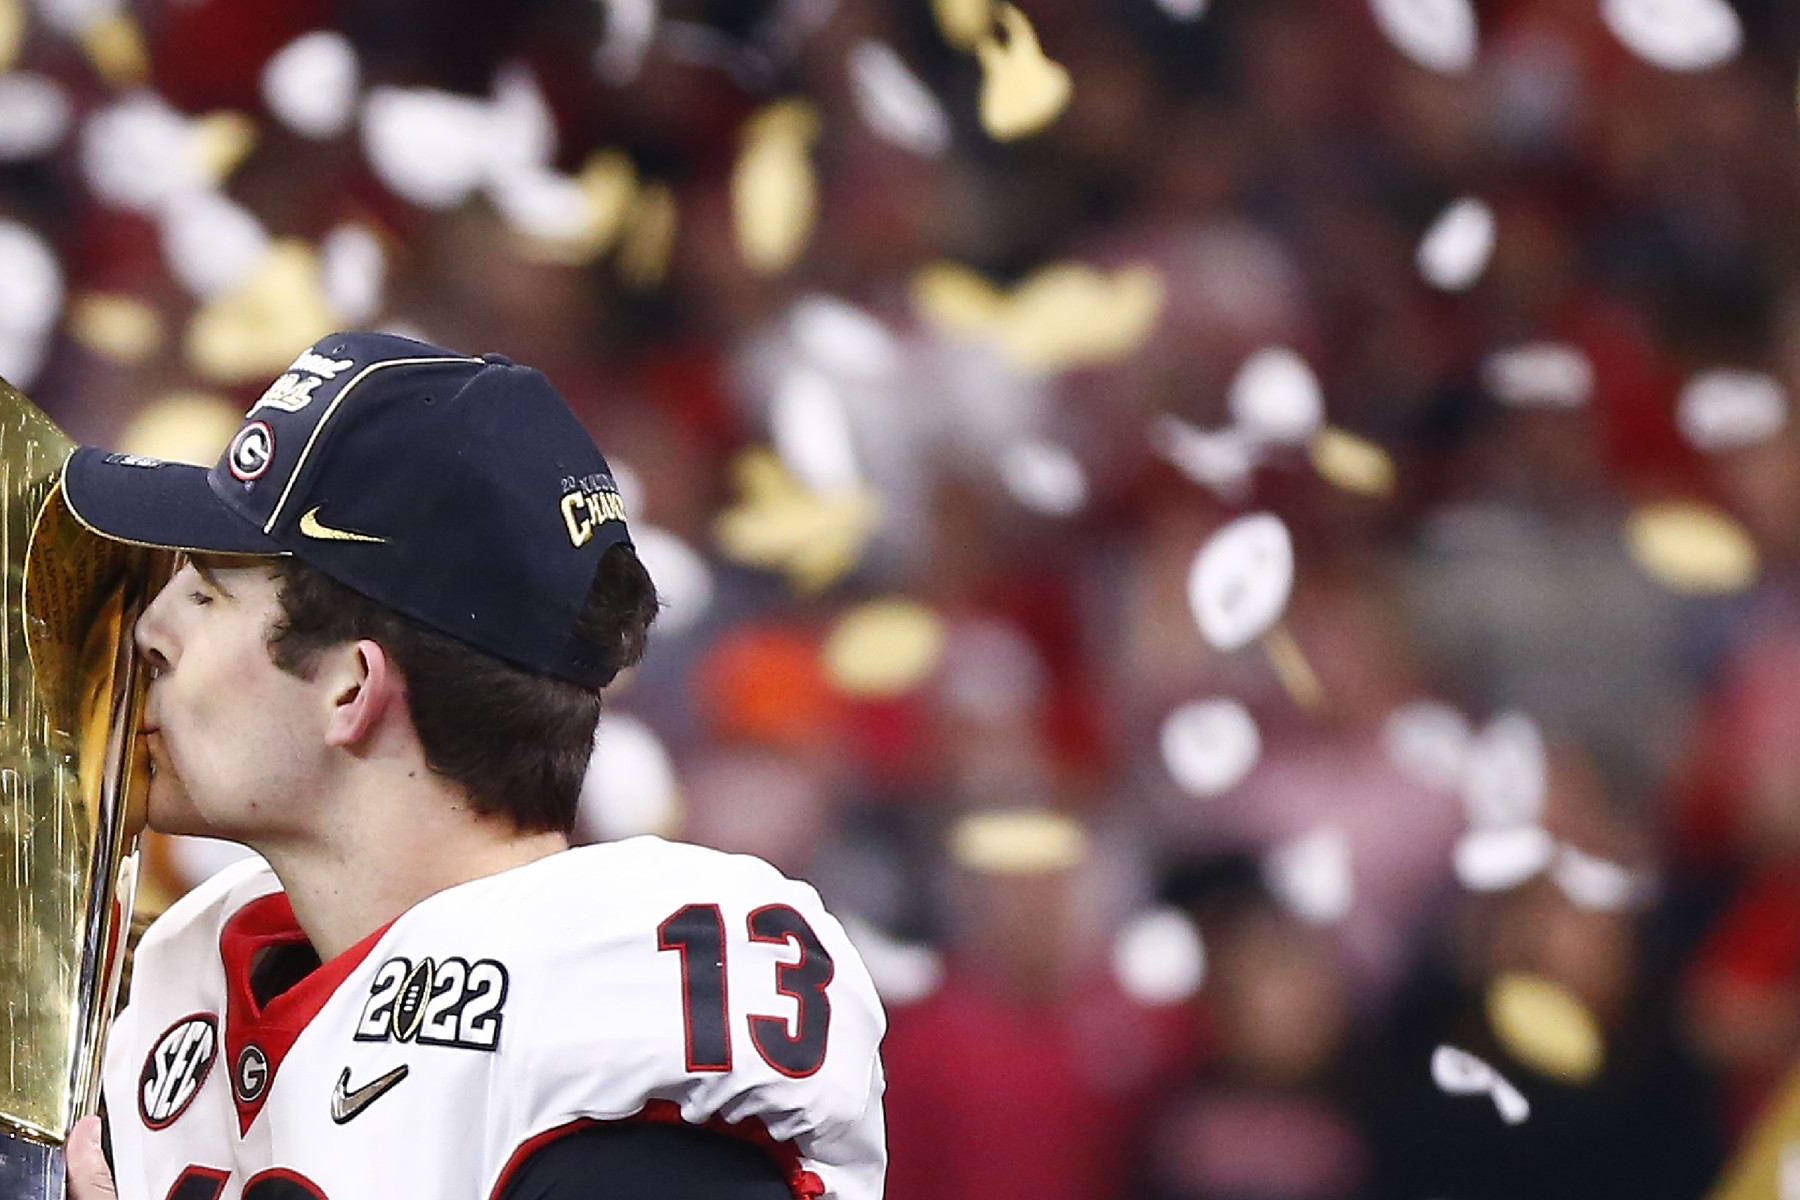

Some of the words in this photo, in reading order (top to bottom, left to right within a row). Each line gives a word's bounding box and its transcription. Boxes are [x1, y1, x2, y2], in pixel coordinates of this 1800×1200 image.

[353, 955, 510, 1051] 2022
[656, 902, 835, 1079] 13
[142, 1020, 215, 1120] SEC
[236, 1044, 269, 1102] G
